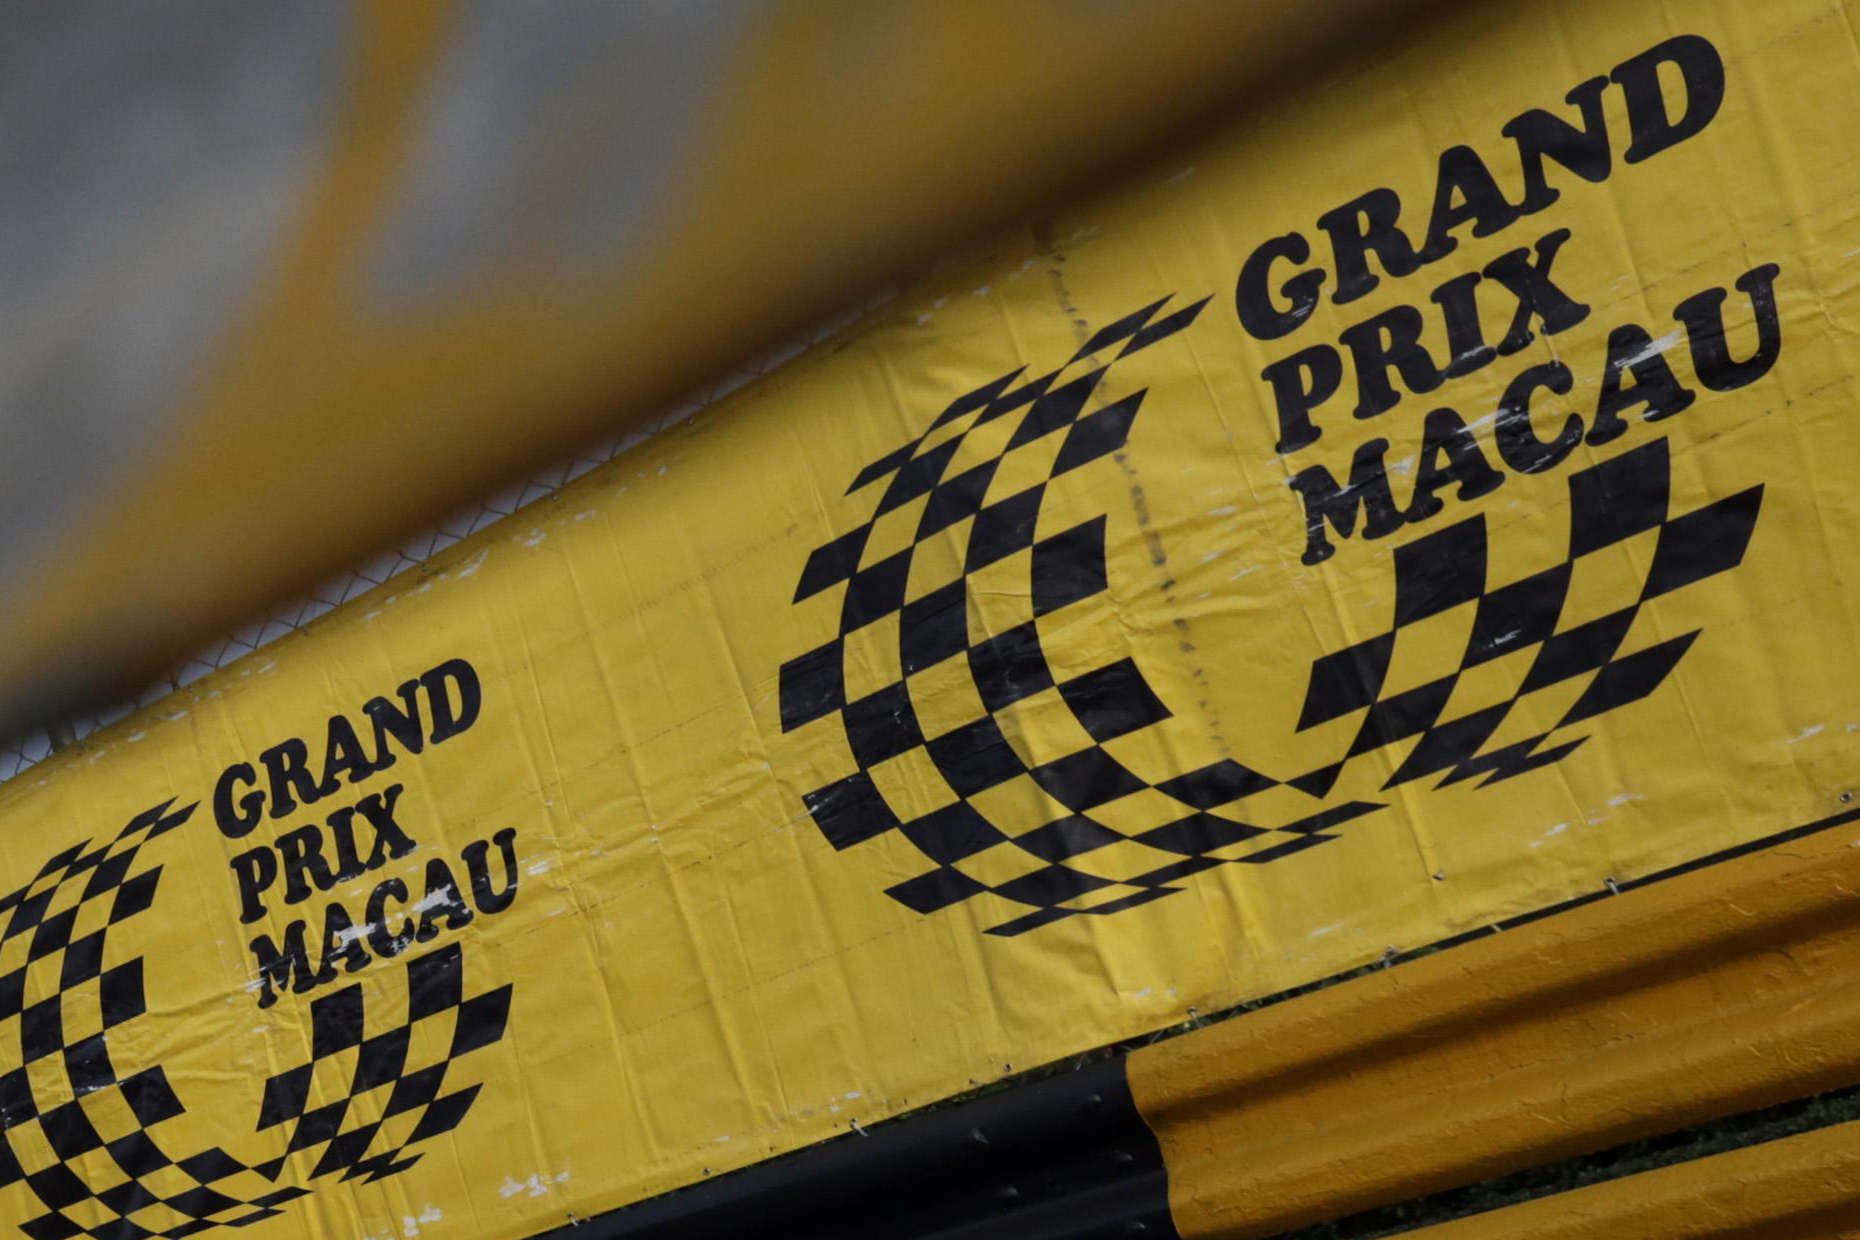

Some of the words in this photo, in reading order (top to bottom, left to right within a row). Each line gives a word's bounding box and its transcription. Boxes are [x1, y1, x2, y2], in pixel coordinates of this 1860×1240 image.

[1235, 34, 1726, 340] GRAND
[1261, 228, 1591, 454] PRIX
[1290, 263, 1781, 566] MACAU
[213, 658, 482, 839] GRAND
[229, 783, 417, 924] PRIX
[249, 827, 519, 1009] MACAU
